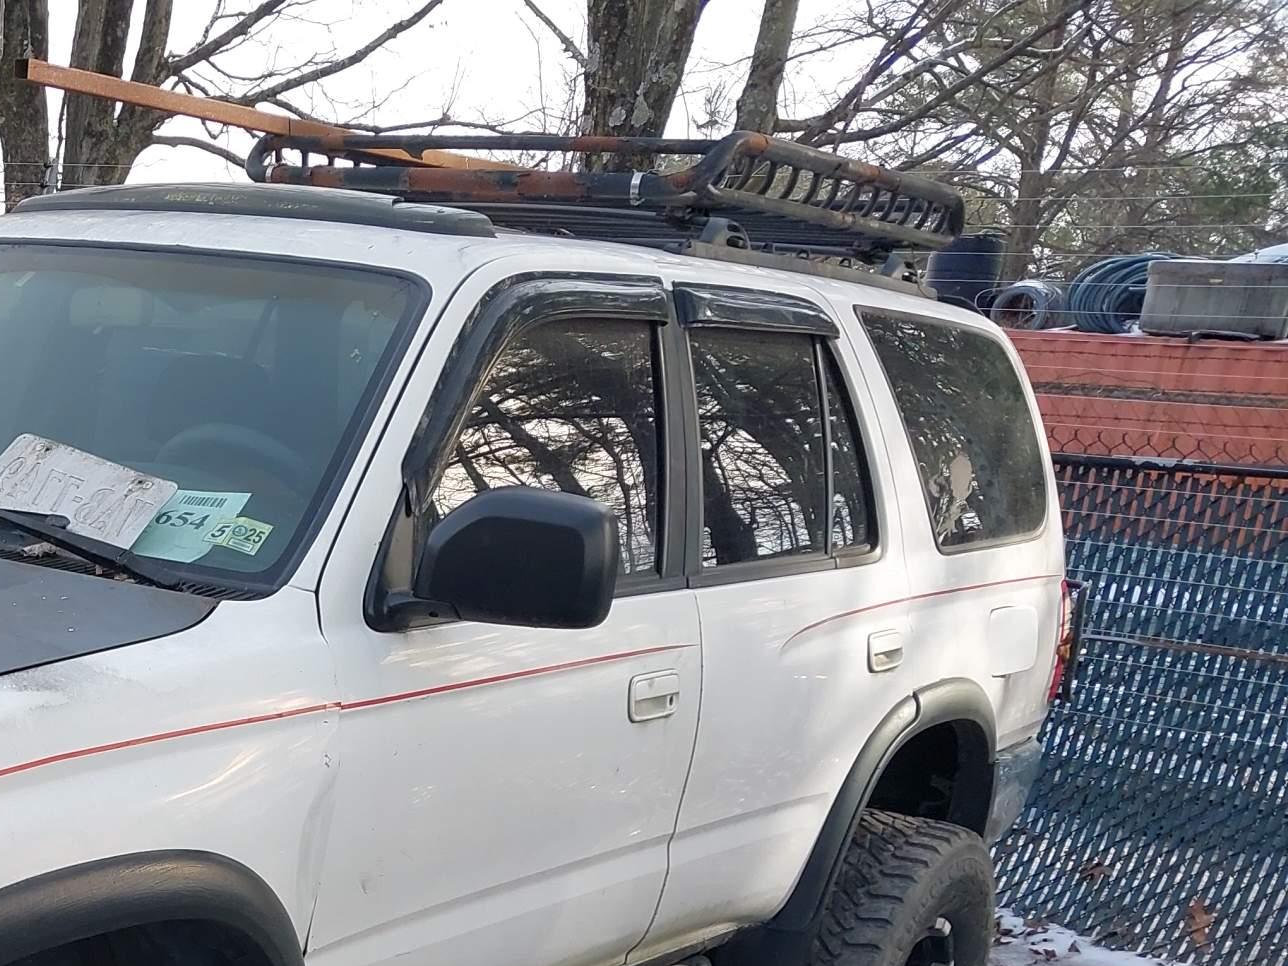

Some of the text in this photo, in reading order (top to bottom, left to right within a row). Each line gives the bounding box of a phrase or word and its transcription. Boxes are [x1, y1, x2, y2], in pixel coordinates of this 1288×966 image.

[155, 510, 210, 530] 654
[211, 525, 232, 538] 5
[244, 527, 265, 544] 25
